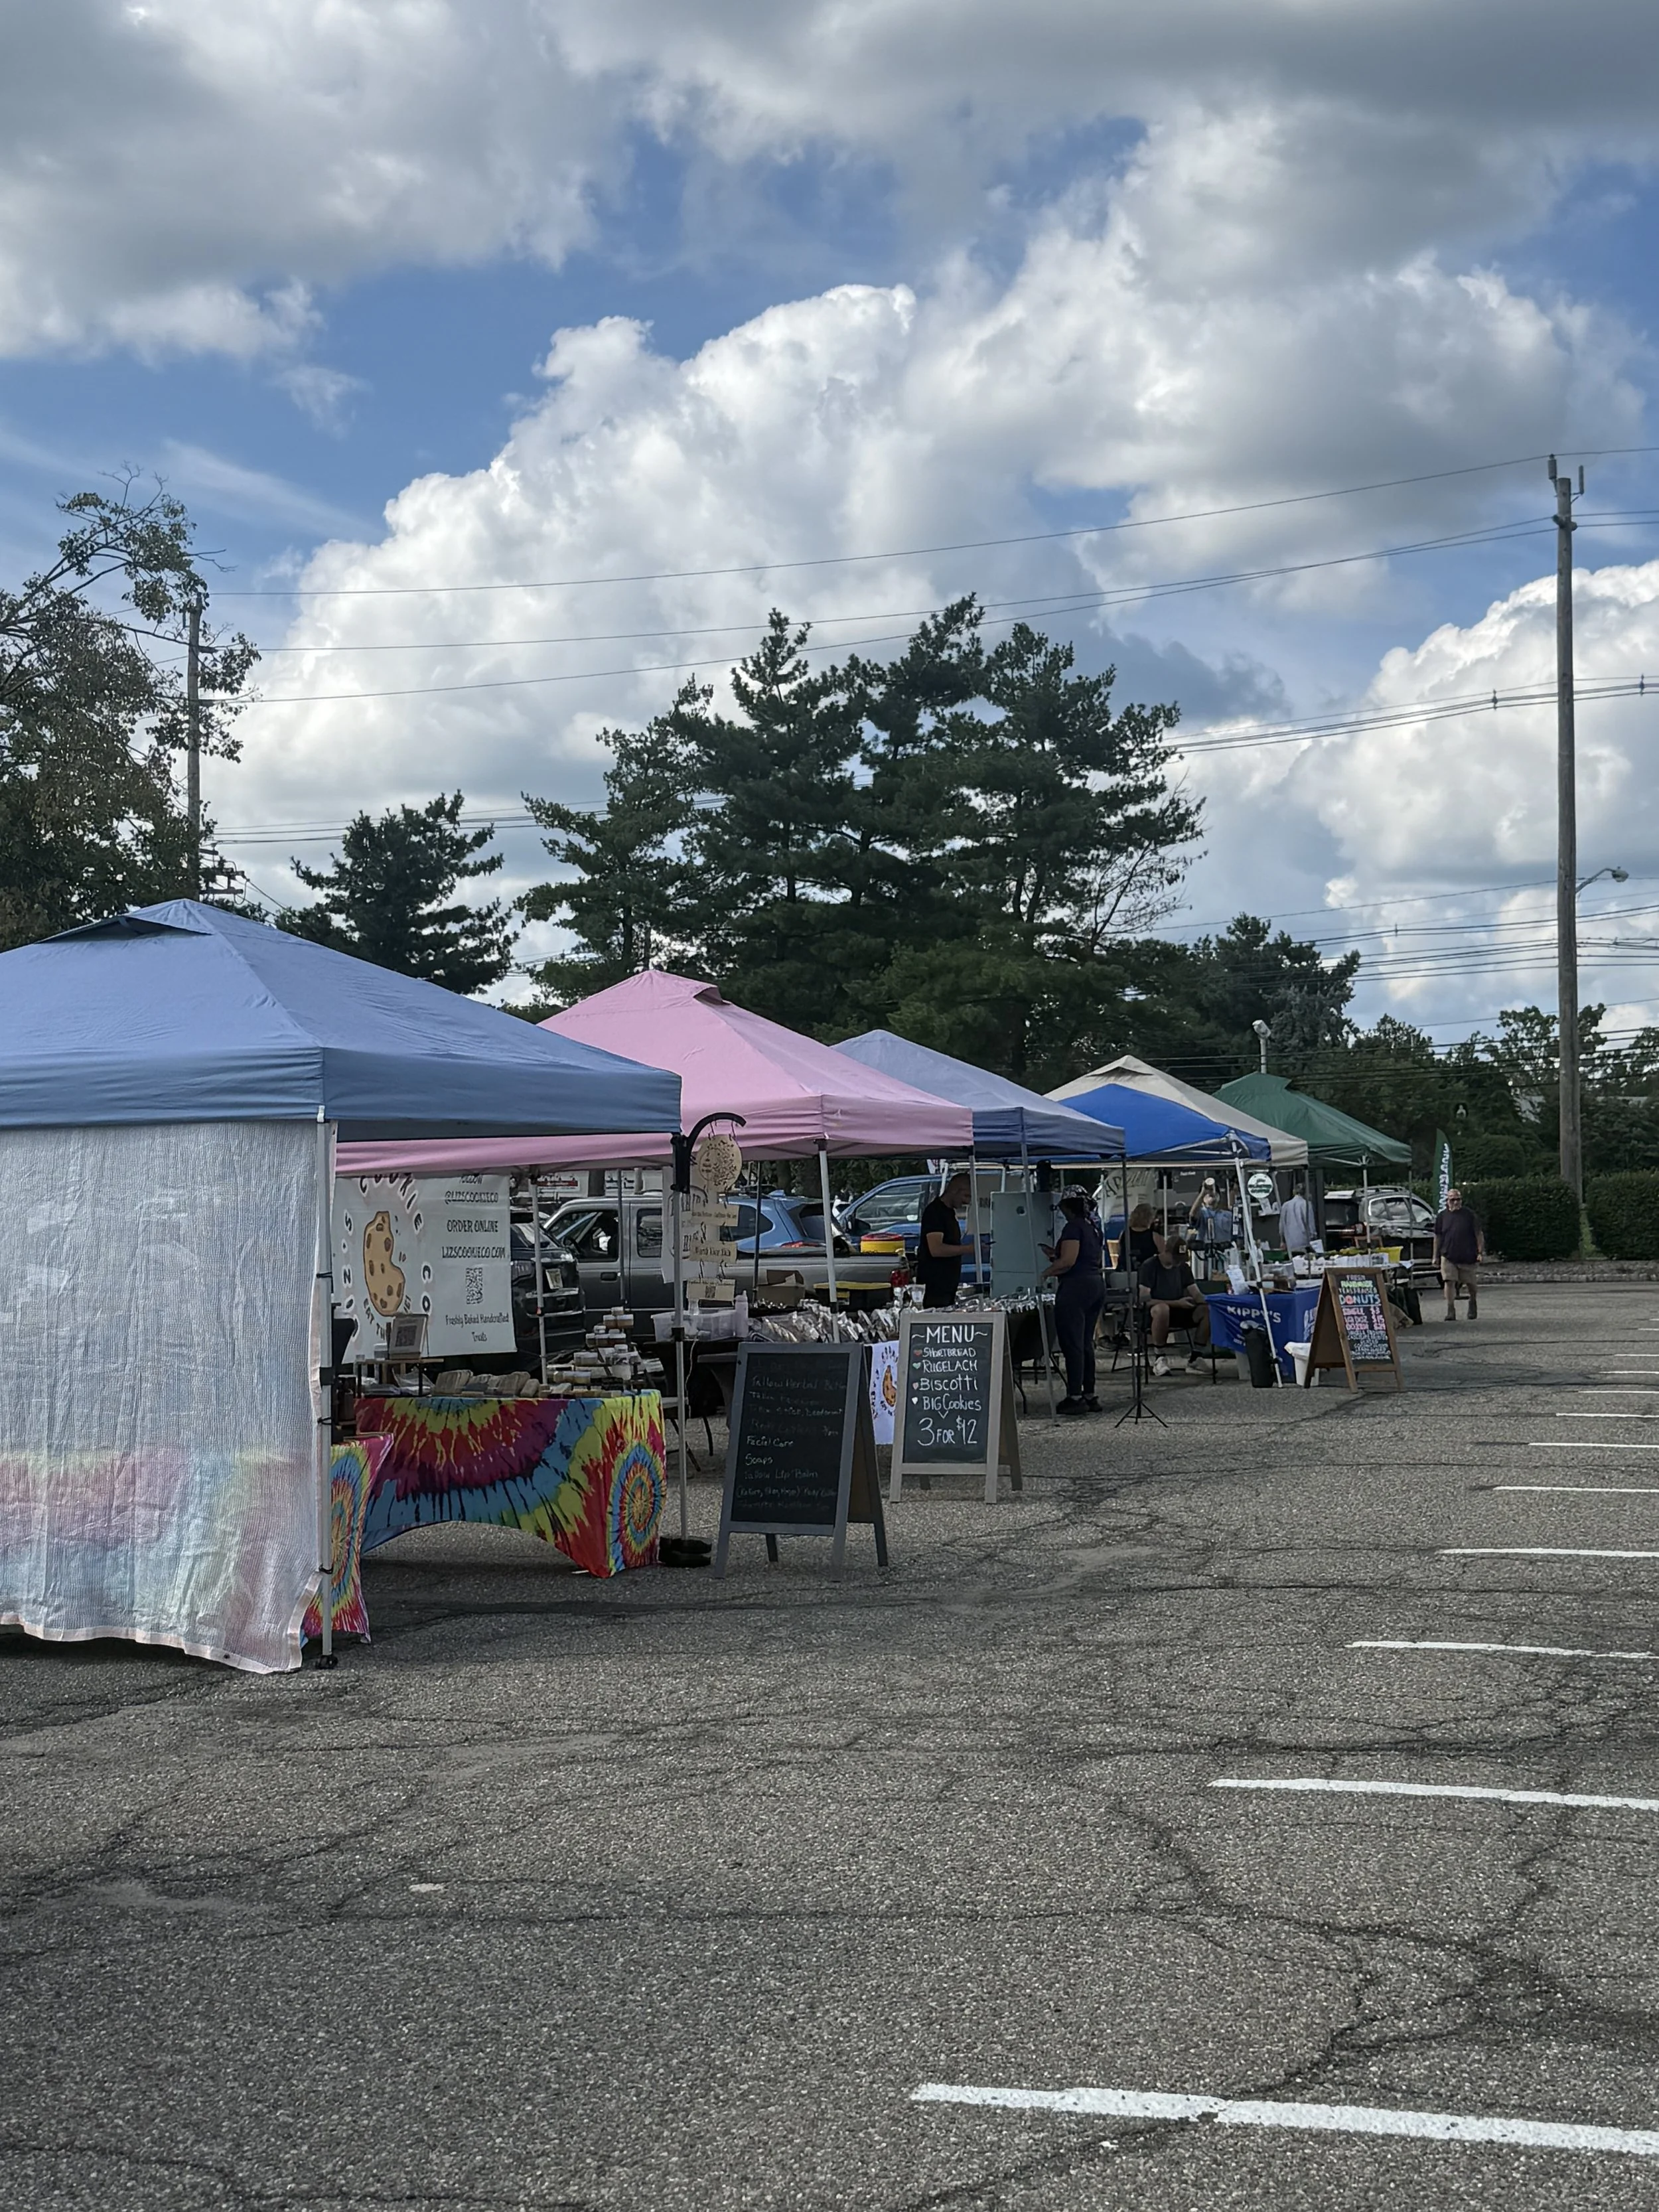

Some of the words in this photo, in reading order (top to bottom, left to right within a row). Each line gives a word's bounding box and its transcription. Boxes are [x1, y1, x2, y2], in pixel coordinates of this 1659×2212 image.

[447, 1220, 473, 1232] ORDER
[474, 1220, 498, 1232] ONLINE
[1338, 1294, 1380, 1305] DONUTS
[922, 1359, 977, 1373] RUGELACH
[922, 1396, 942, 1410] BIG
[942, 1393, 982, 1411] Cookies
[917, 1417, 935, 1446] 3
[936, 1428, 956, 1444] FOR
[956, 1415, 978, 1445] $12
[747, 1436, 771, 1447] Facial
[772, 1438, 794, 1447] Care
[745, 1453, 774, 1465] Soaps
